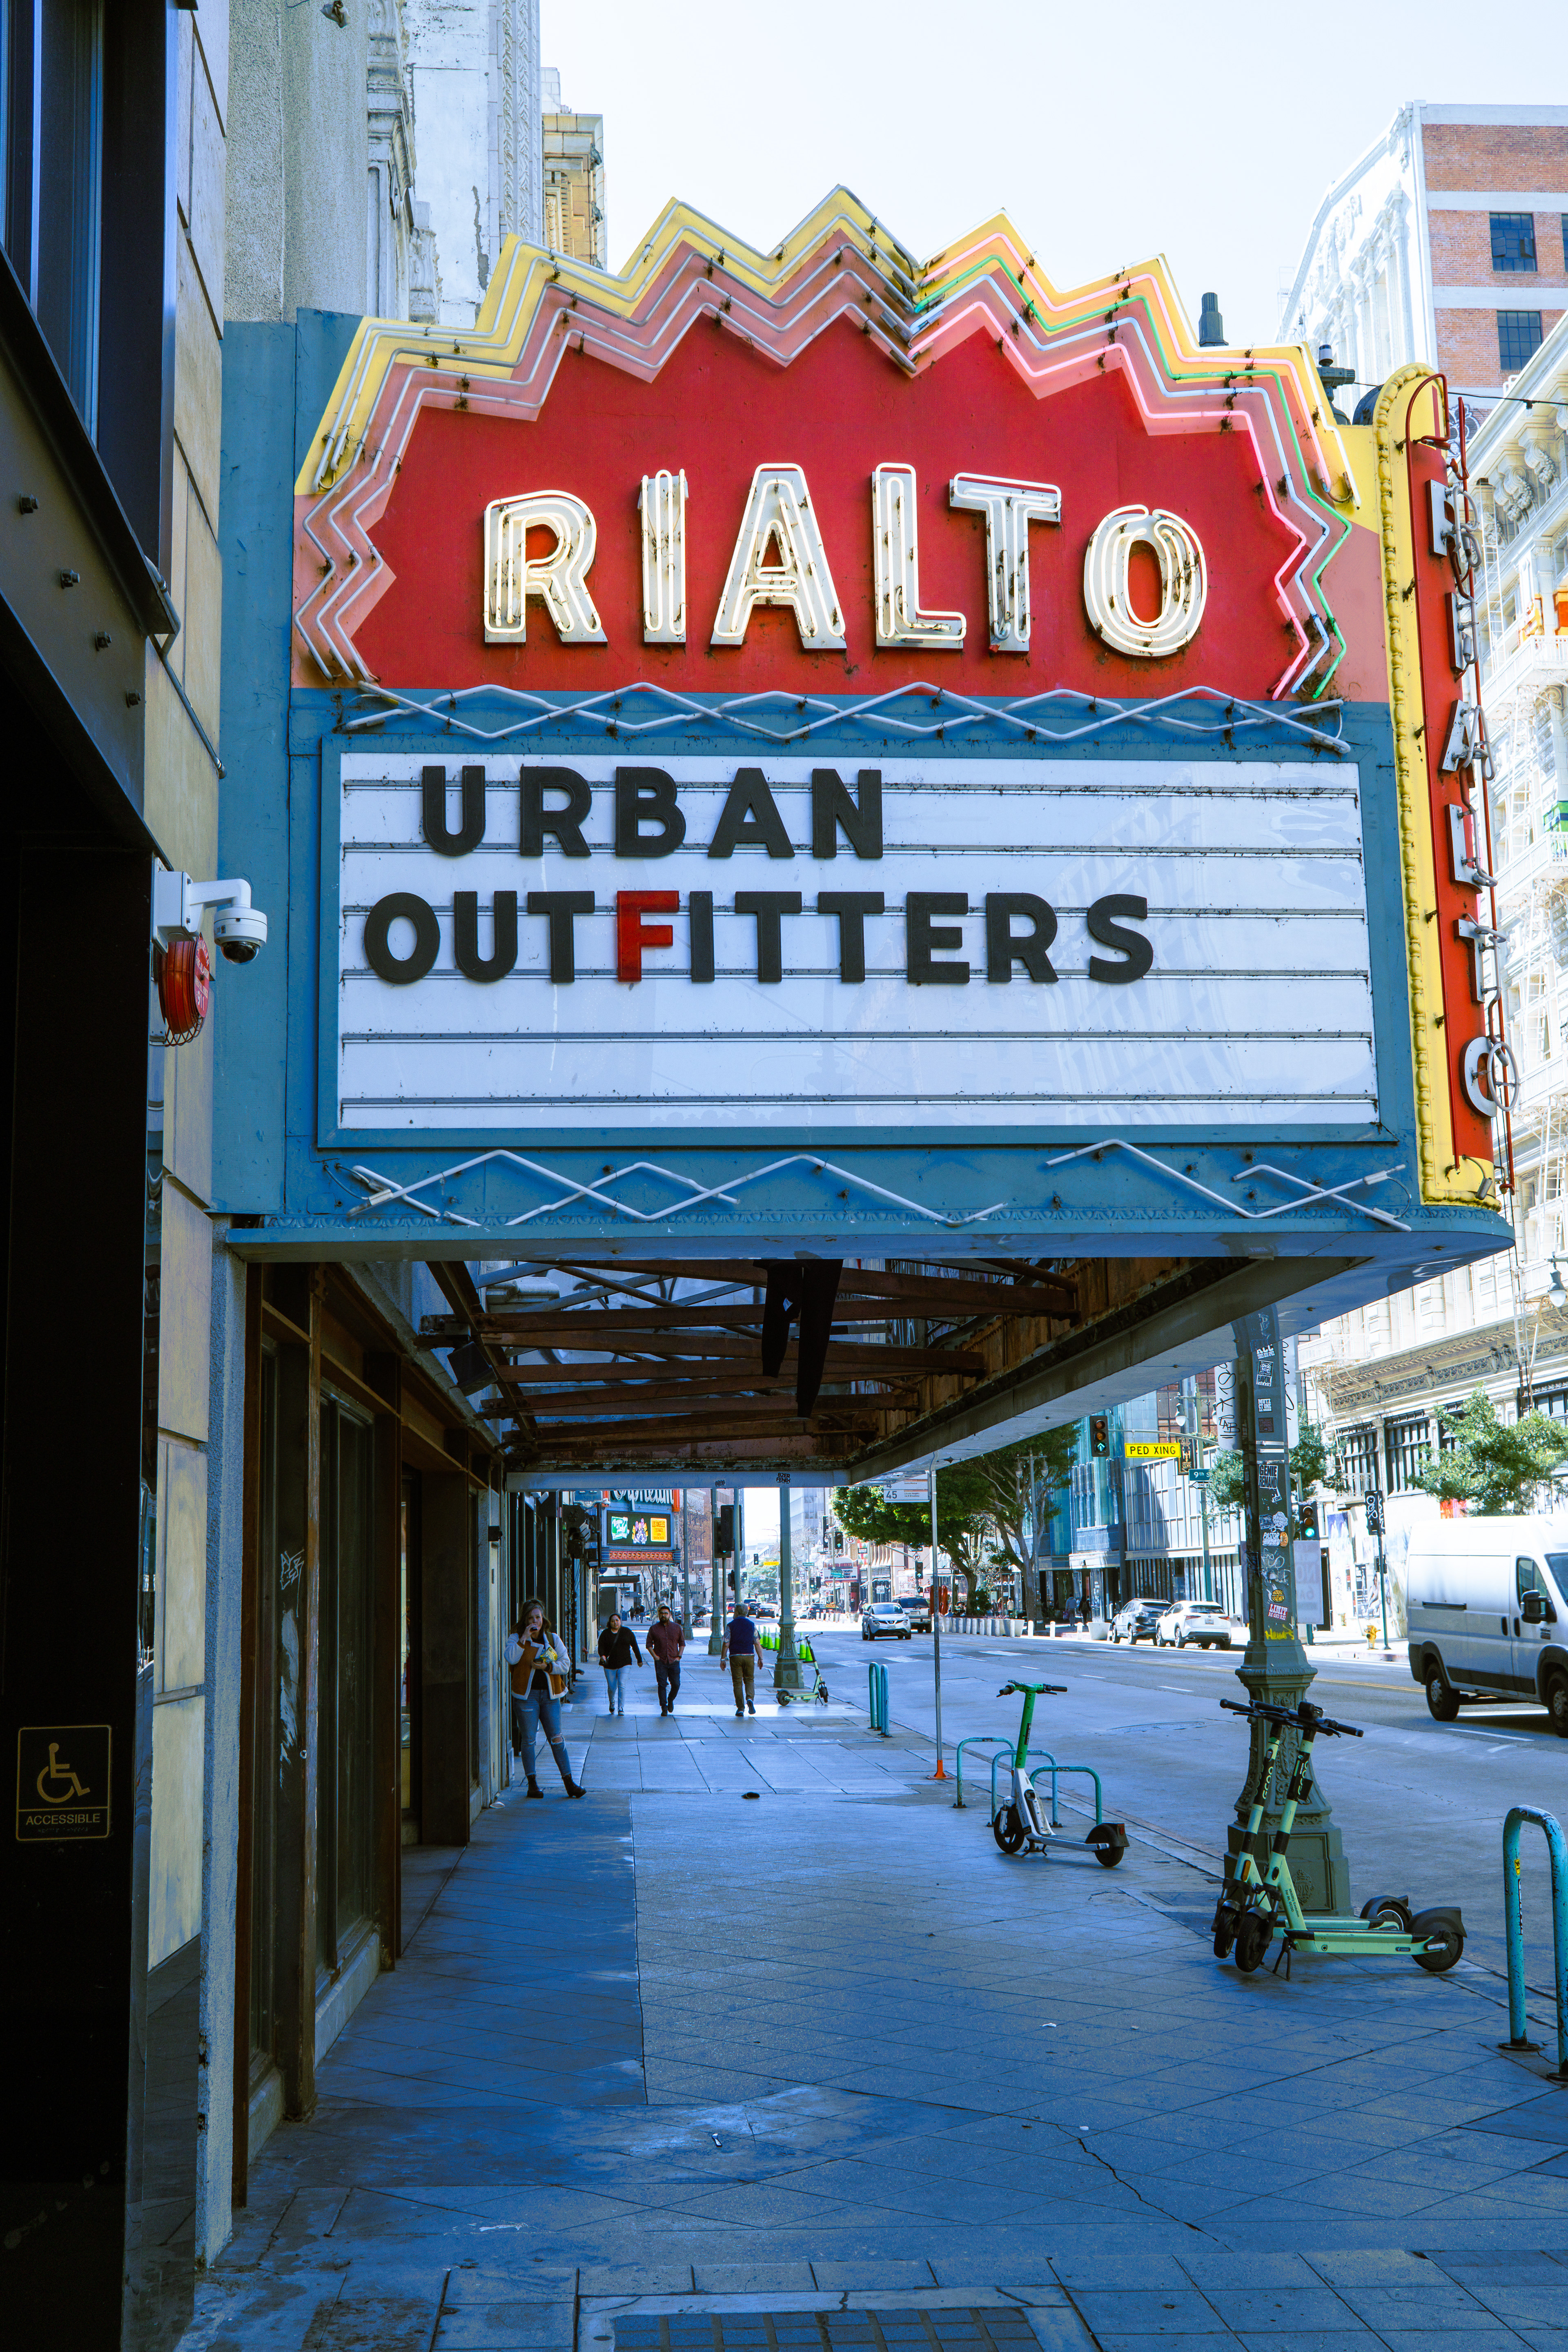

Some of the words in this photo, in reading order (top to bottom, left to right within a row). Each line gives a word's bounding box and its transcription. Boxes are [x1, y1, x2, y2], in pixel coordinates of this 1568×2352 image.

[483, 463, 1208, 658] RIALTO
[422, 765, 884, 858] URBAN
[363, 890, 1154, 984] OUTFITTERS
[1130, 1446, 1149, 1454] PED
[1154, 1446, 1176, 1454] XING
[1259, 1465, 1277, 1477] GENIE
[1259, 1476, 1277, 1488] REMAND
[886, 1491, 897, 1499] 45
[1269, 1604, 1288, 1616] LIMIT
[26, 1813, 100, 1825] ACCESSIBLE
